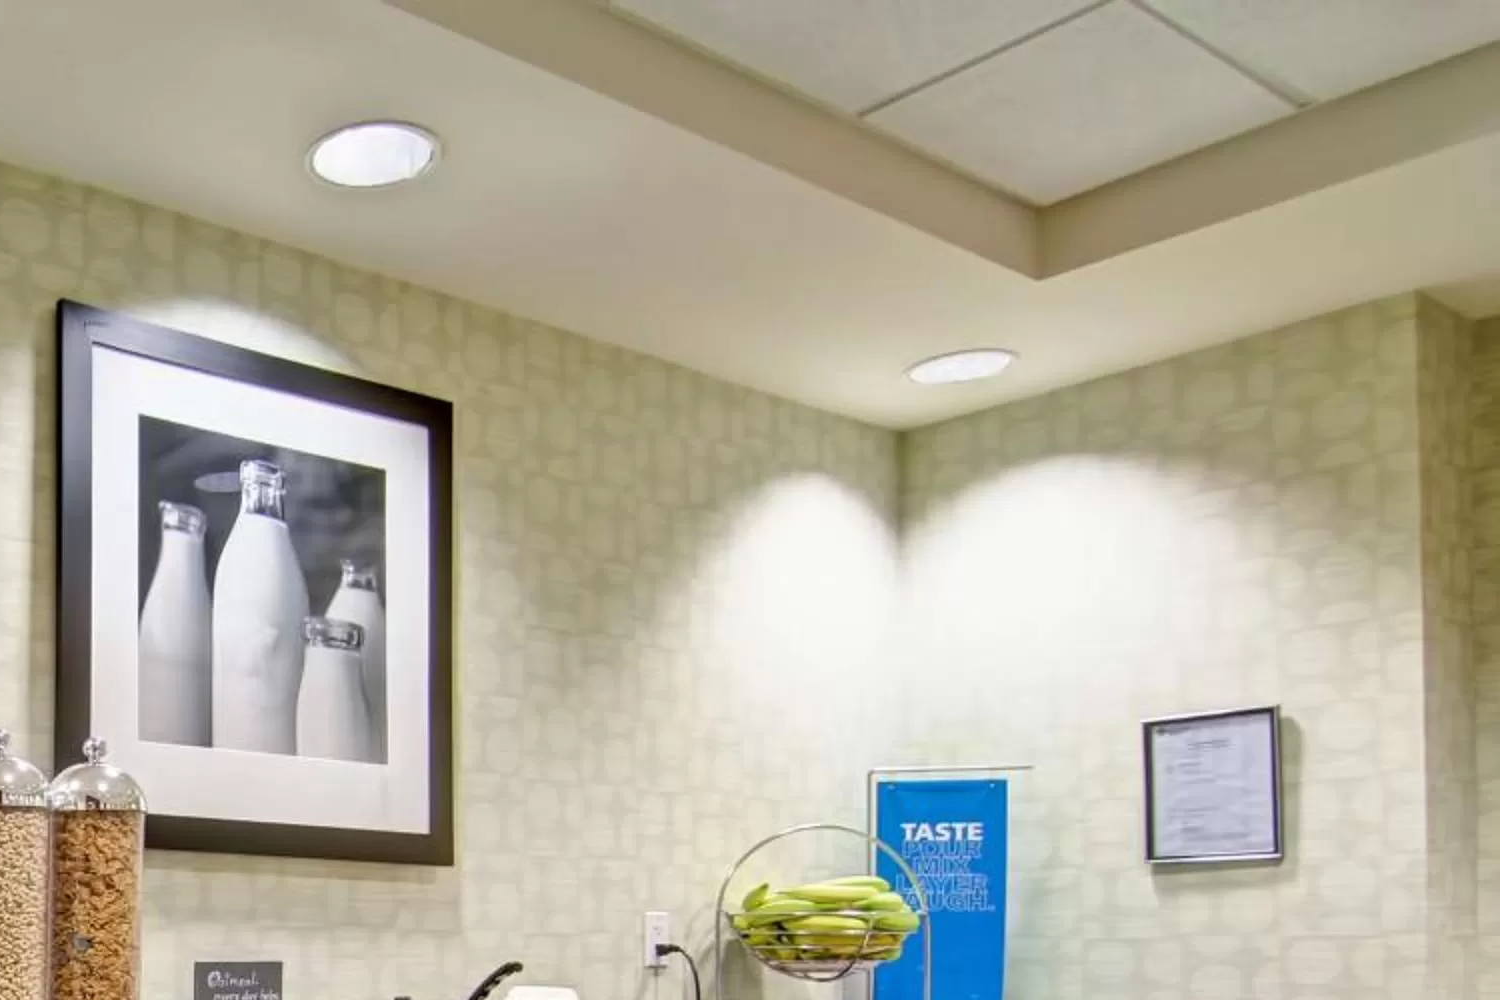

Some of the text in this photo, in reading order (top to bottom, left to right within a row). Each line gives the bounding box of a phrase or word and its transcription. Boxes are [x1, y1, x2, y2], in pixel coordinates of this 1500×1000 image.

[900, 822, 984, 841] TASTE
[902, 840, 982, 858] POUR
[912, 856, 971, 875] MIX
[896, 873, 988, 894] LAYER
